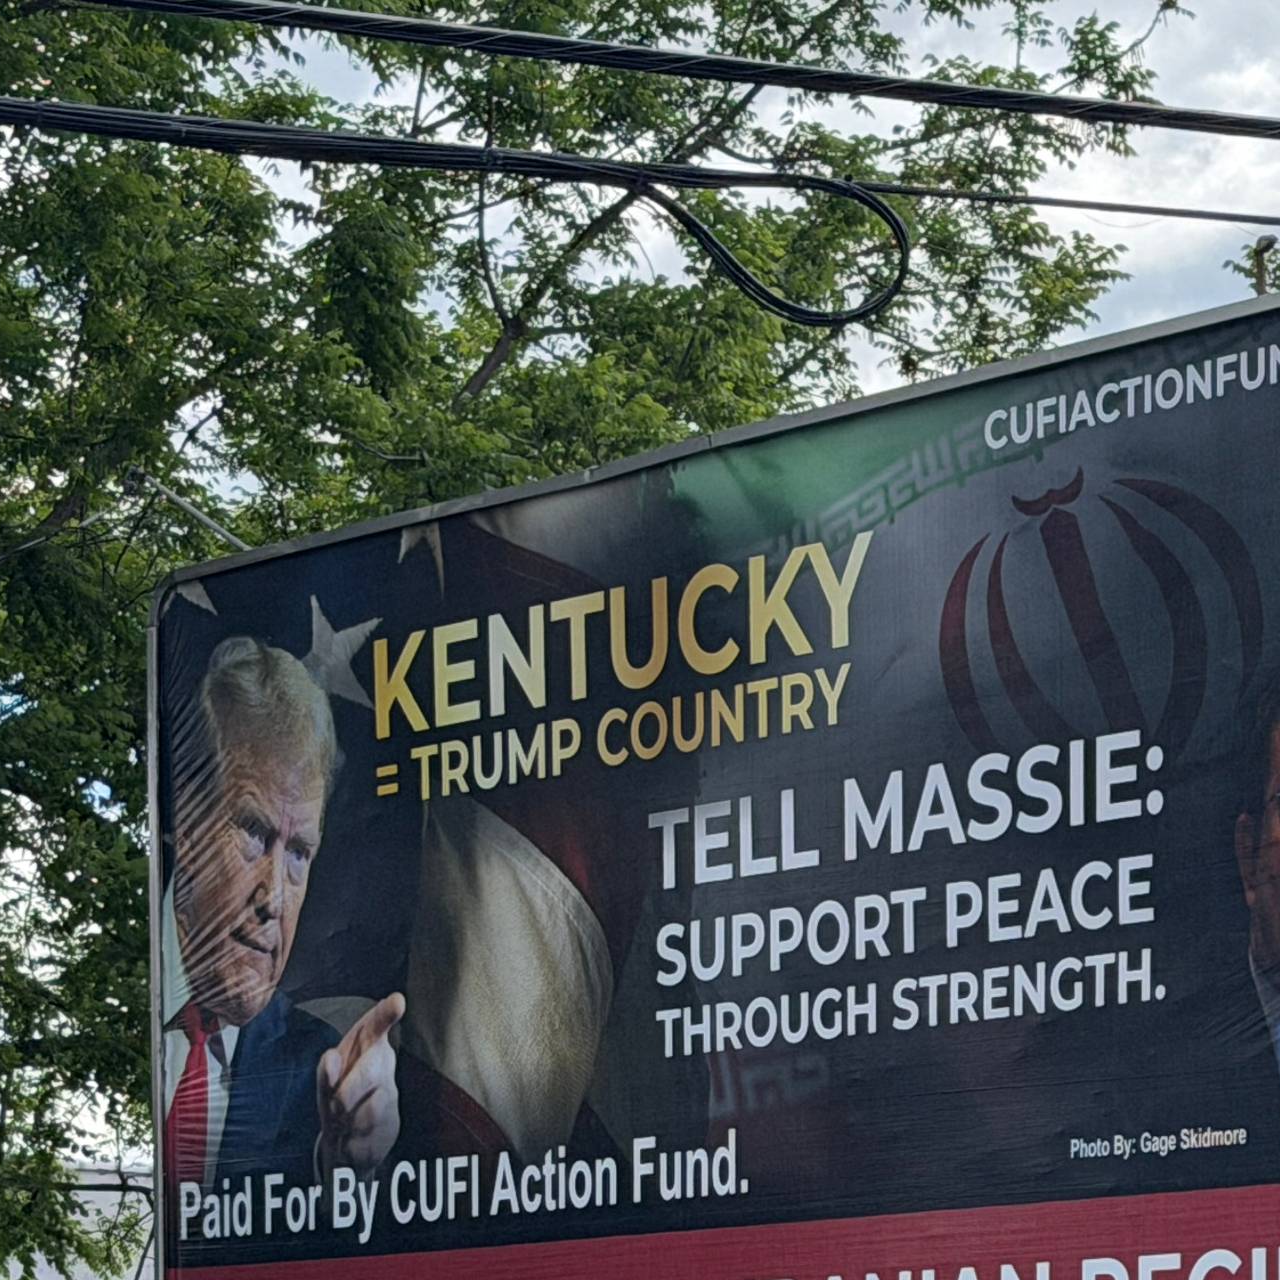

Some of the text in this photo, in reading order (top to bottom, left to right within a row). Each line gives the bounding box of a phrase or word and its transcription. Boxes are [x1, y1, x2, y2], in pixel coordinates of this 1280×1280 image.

[372, 531, 874, 740] KENTUCKY
[410, 718, 582, 800] TRUMP
[596, 662, 852, 768] COUNTRY
[648, 729, 1164, 890] TELL MASSIE:
[656, 854, 1155, 987] SUPPORT PEACE
[655, 947, 1167, 1058] THROUGH STRENGTH.
[179, 1128, 750, 1245] Paid For By CUFI Action Fund.
[1070, 1127, 1248, 1160] Photo By: Gage Skidmore
